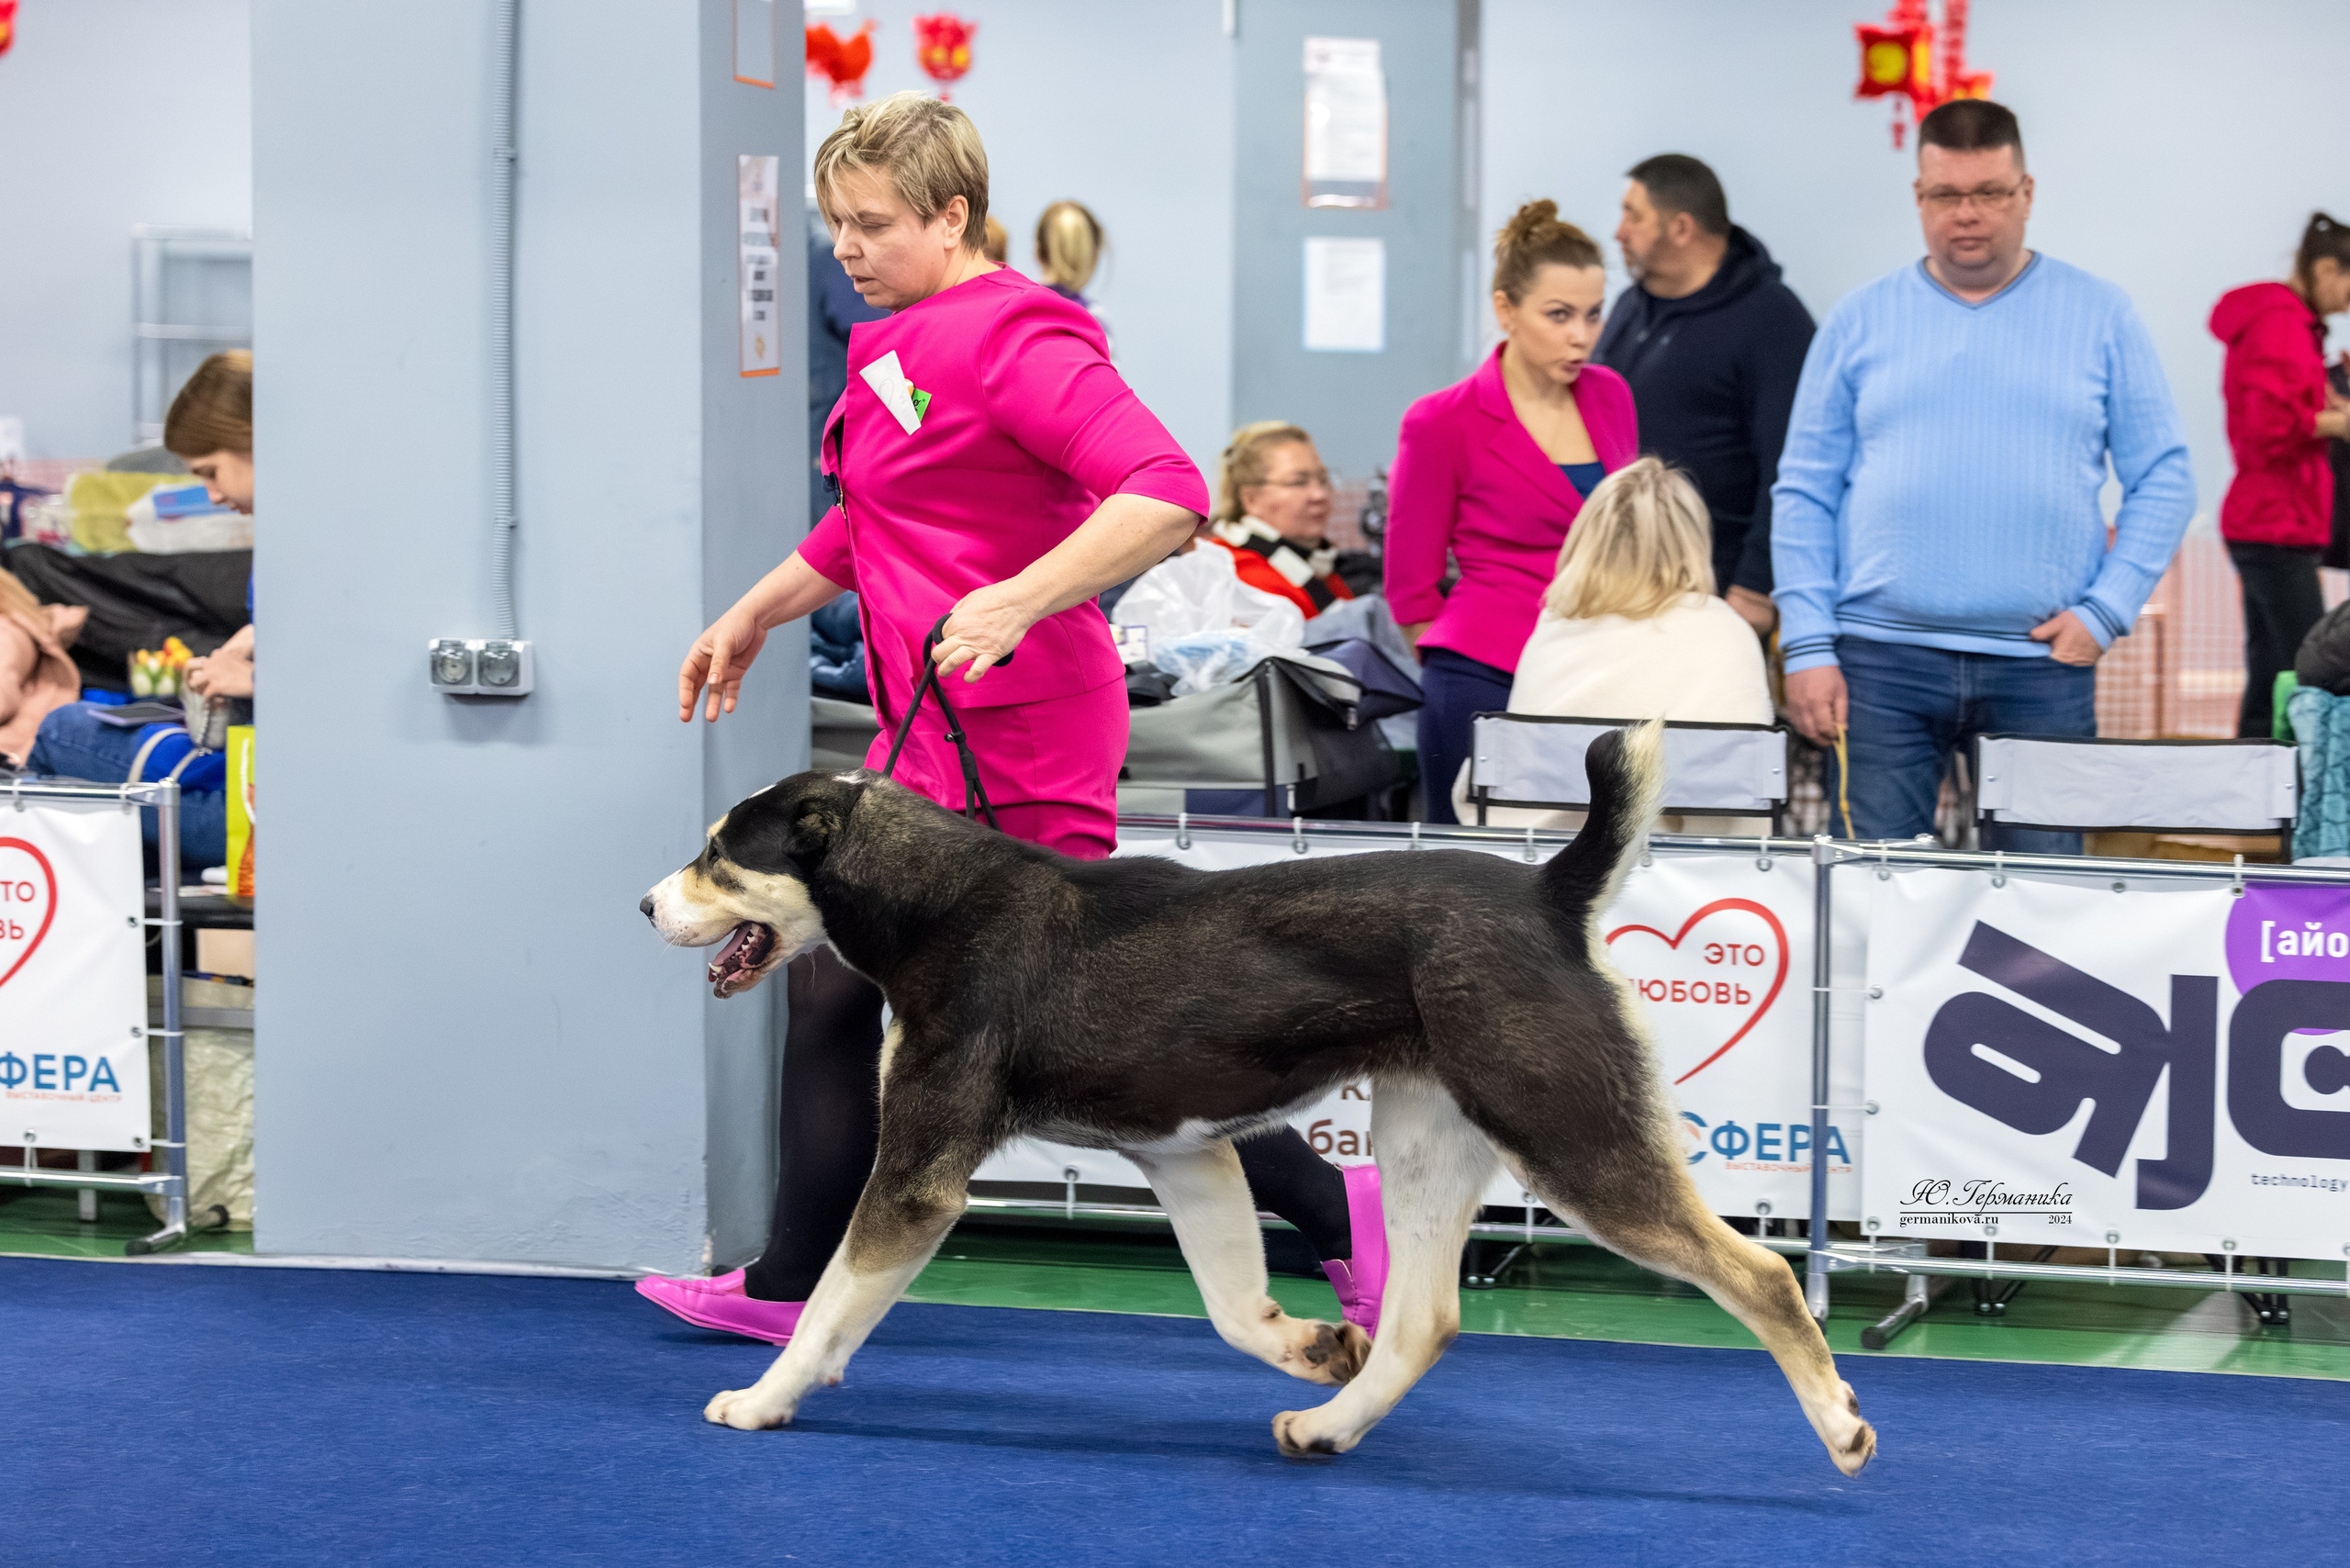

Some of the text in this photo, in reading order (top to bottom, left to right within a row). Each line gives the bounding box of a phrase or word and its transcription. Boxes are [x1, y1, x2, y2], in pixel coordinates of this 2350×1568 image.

[1705, 943, 1764, 966] ЭТО
[1629, 979, 1751, 1005] ЮБОВЬ
[0, 1051, 120, 1092] ФЕРА
[2251, 1172, 2350, 1193] technology
